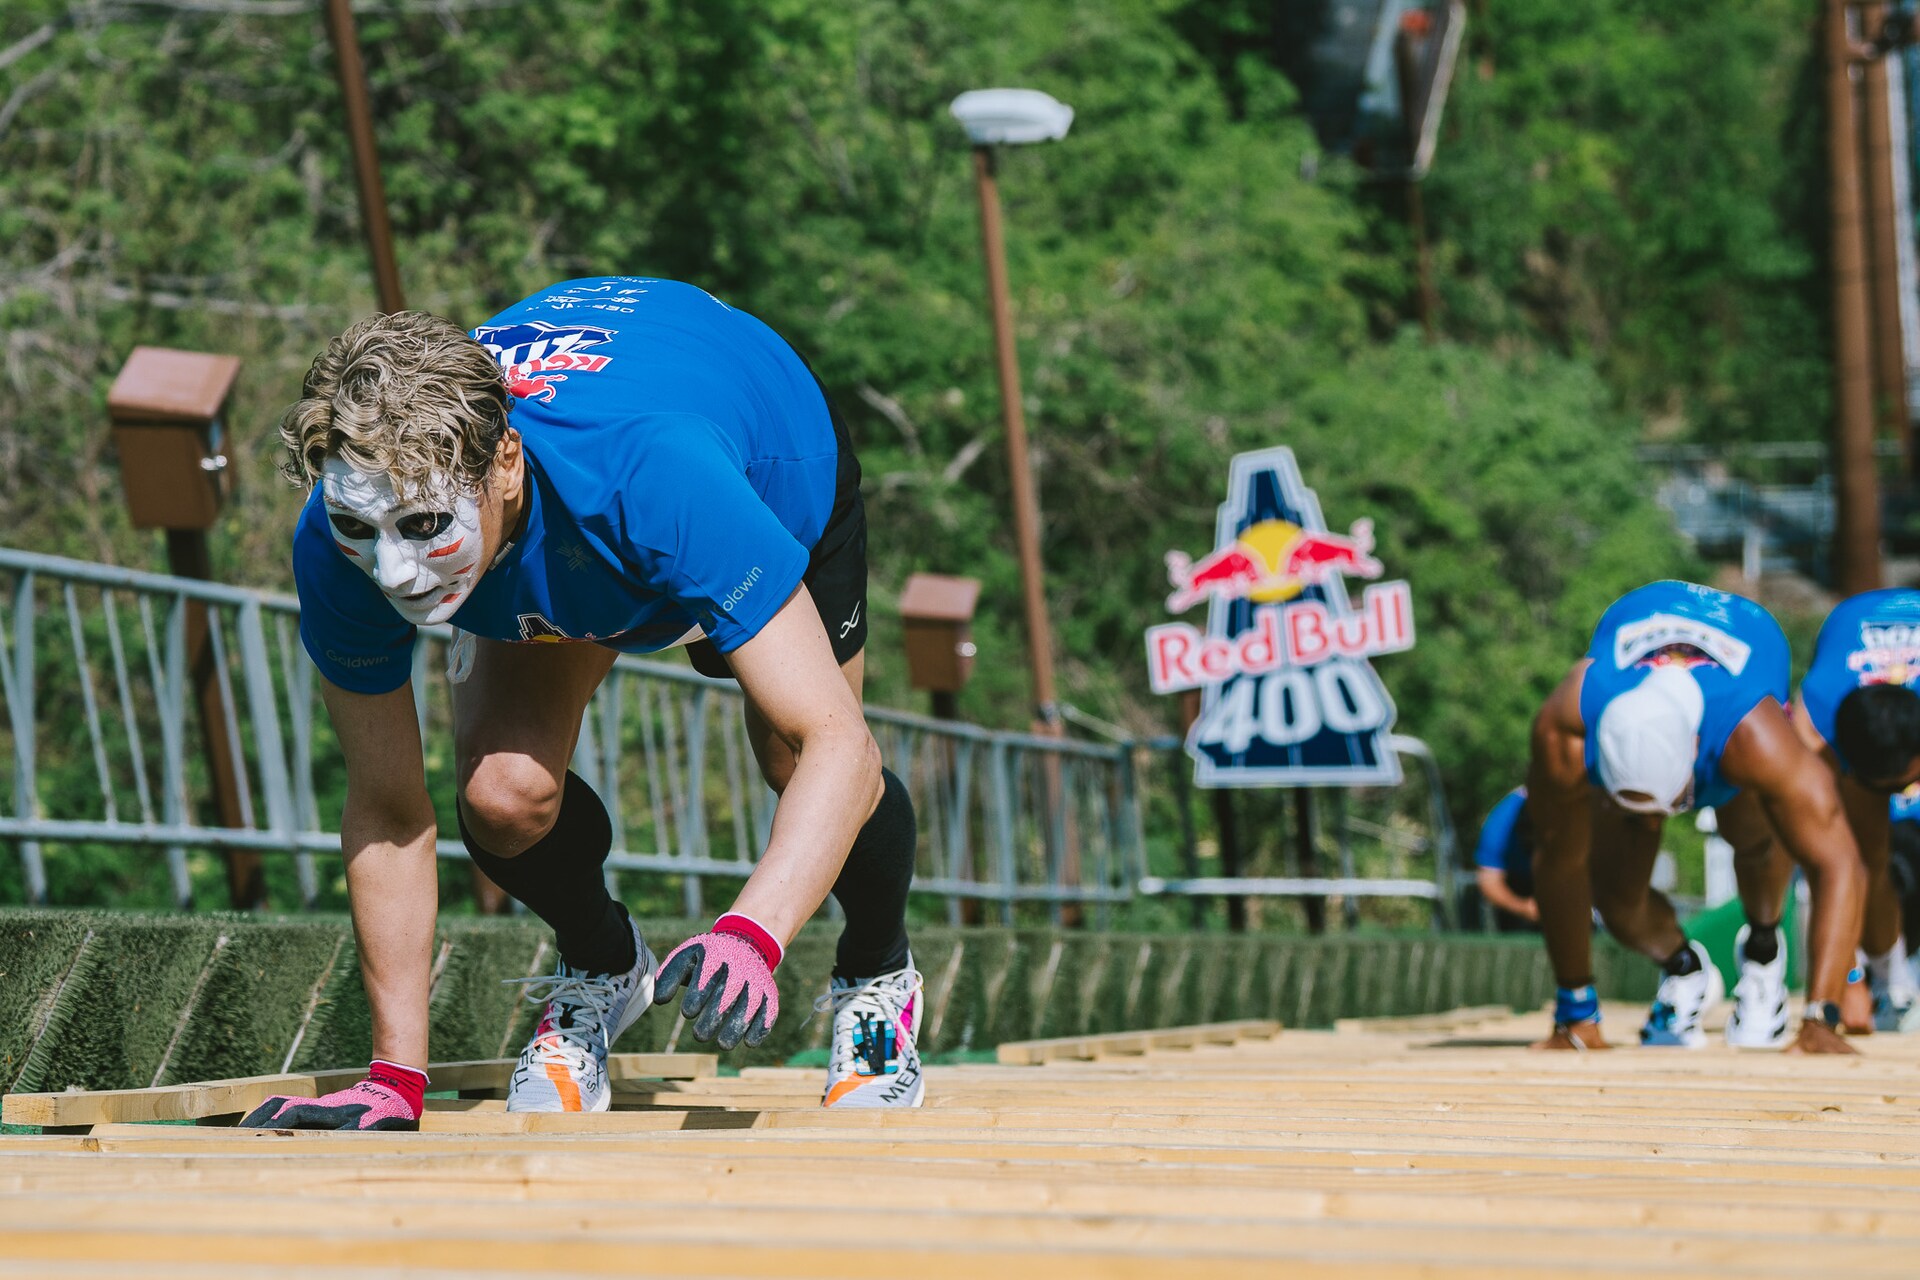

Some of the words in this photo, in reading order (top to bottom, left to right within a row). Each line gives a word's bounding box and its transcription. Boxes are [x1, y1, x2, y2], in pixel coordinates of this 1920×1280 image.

[325, 649, 390, 669] Goldwin
[1155, 612, 1277, 689] Red
[1288, 589, 1406, 659] Bull
[1200, 662, 1387, 753] 400
